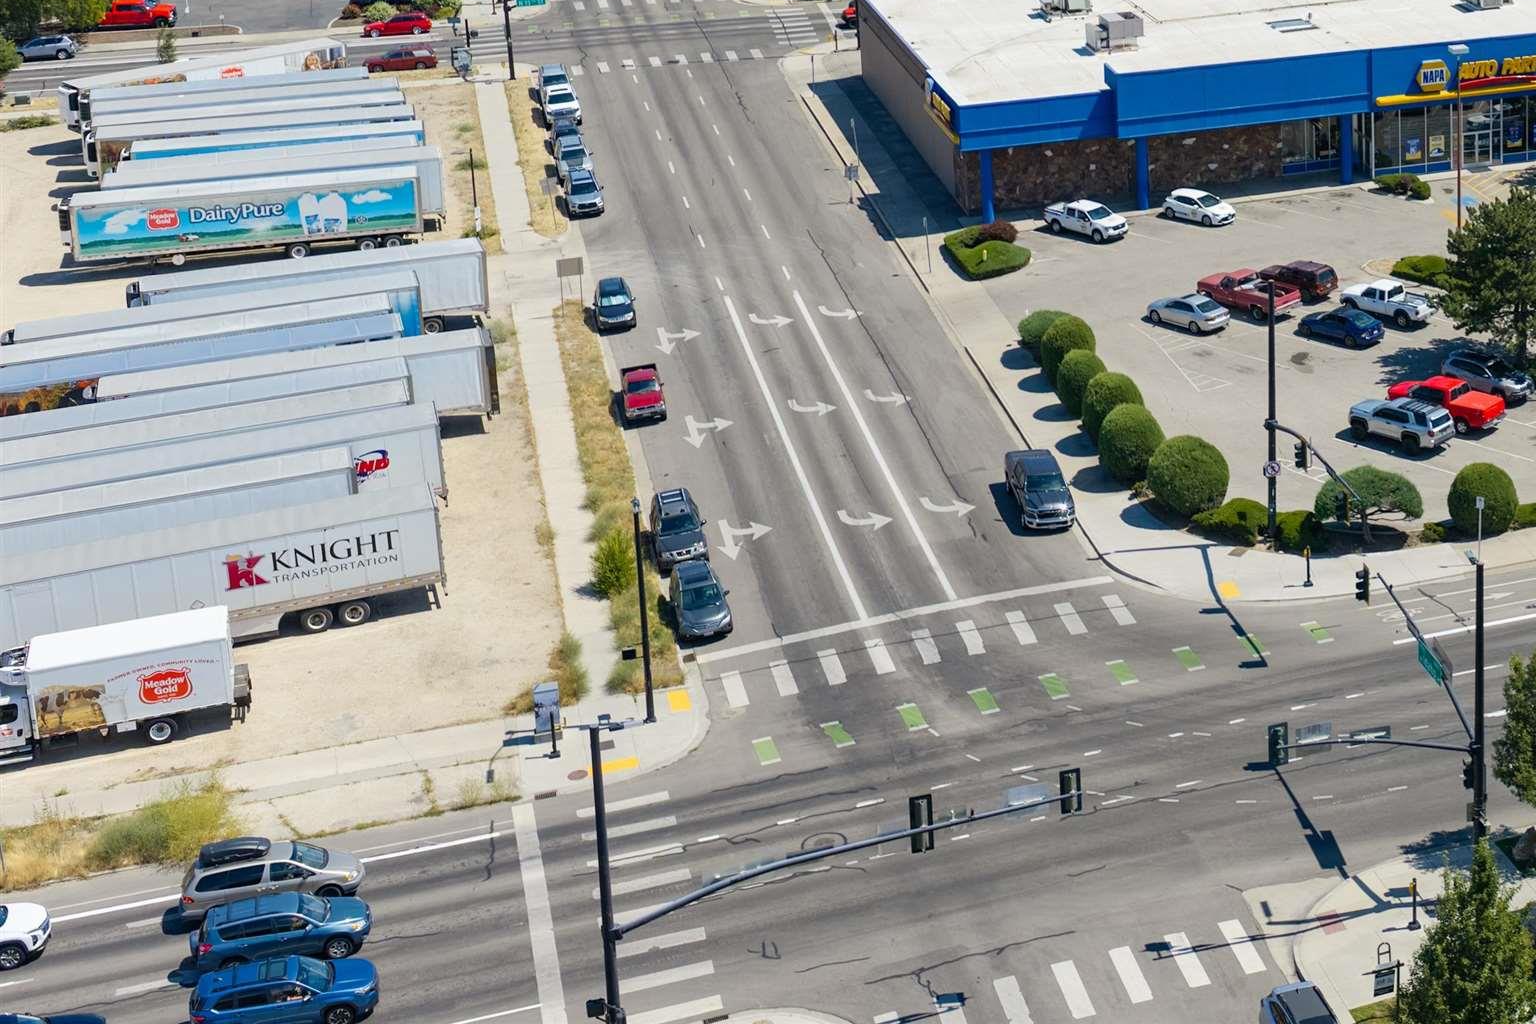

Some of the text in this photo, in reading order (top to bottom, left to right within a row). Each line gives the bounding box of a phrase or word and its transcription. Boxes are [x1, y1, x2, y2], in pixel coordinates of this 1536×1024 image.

[1423, 69, 1445, 84] NAPA
[1459, 59, 1499, 79] AUTO
[271, 529, 399, 572] KNIGHT
[273, 554, 398, 584] TRANSPORTATION
[145, 675, 185, 689] Meadow
[154, 684, 178, 695] Gold
